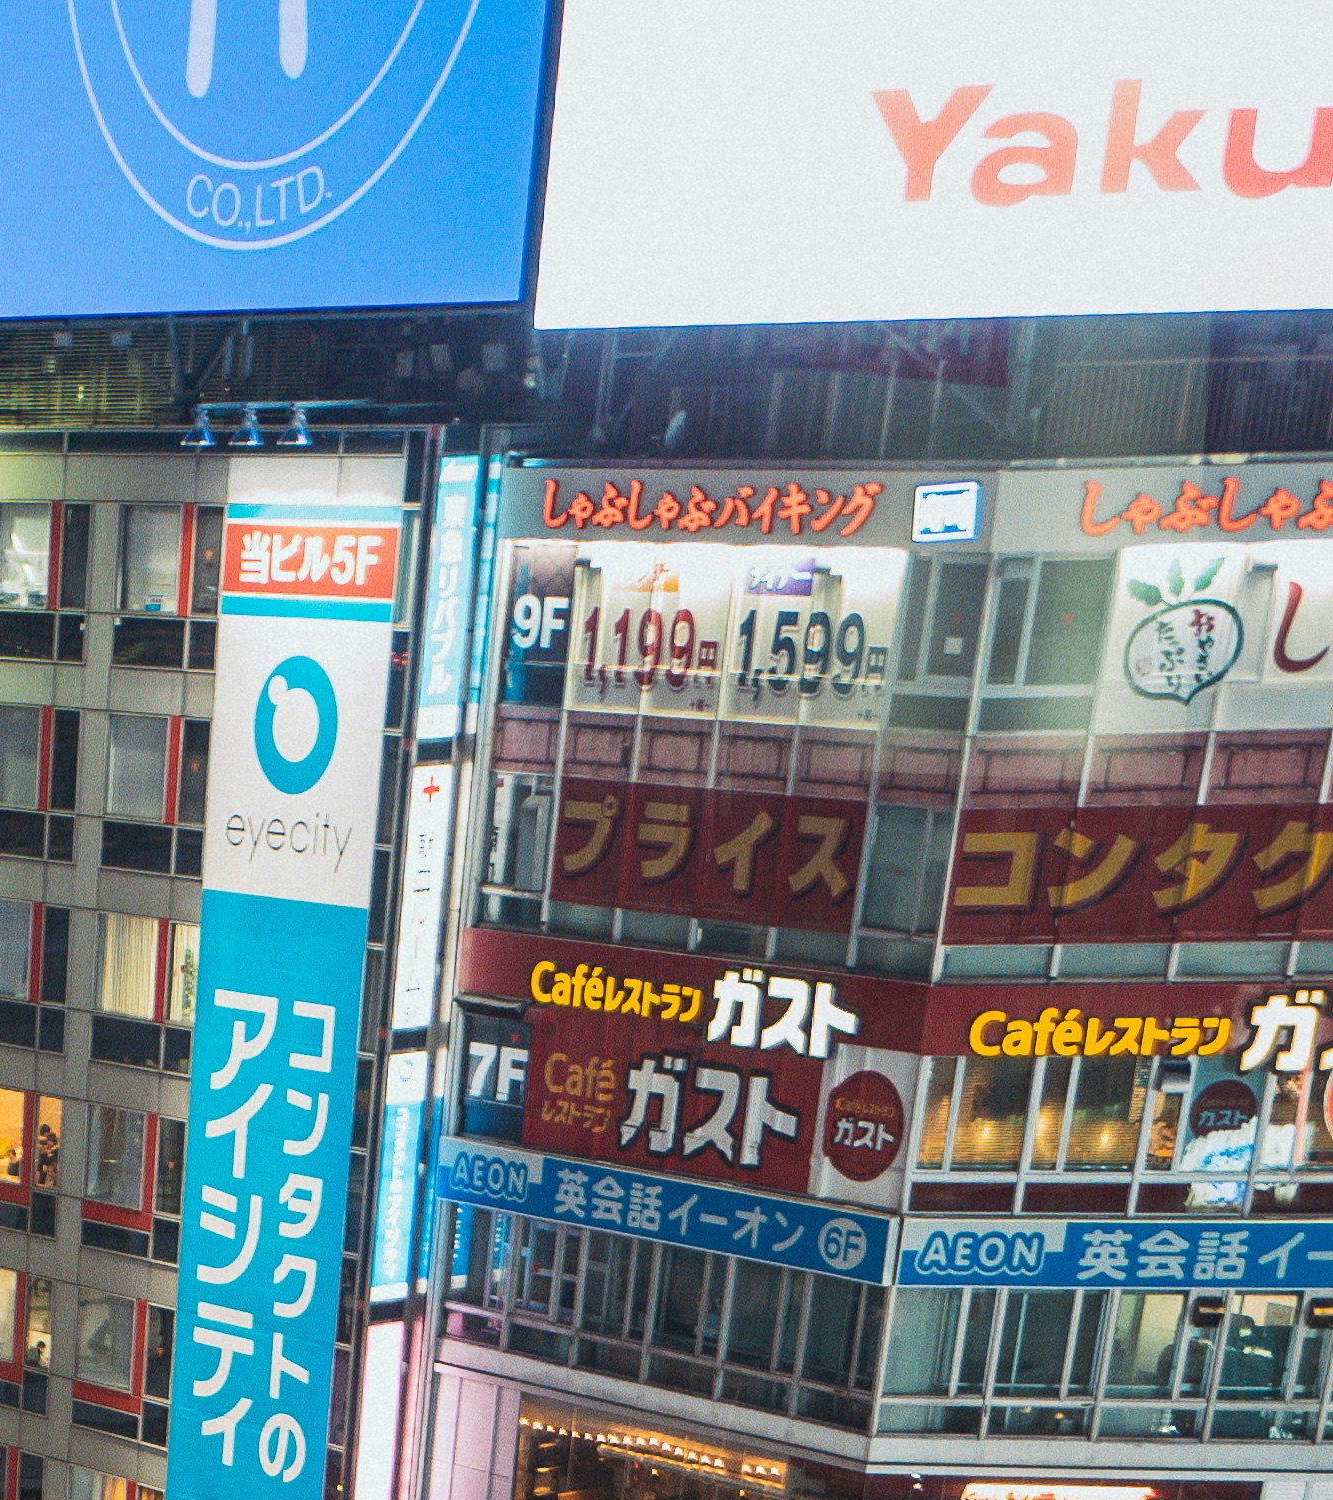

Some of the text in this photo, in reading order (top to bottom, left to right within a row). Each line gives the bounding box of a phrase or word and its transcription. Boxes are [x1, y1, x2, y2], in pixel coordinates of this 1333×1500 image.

[542, 479, 883, 537] しゃぶしゃぶバイキング
[239, 529, 385, 586] 当ビル5F
[511, 594, 570, 650] 9F
[225, 812, 353, 873] eyecity
[562, 794, 851, 897] プライス
[707, 967, 859, 1059] ガスト
[468, 1041, 530, 1102] 7F
[543, 1053, 617, 1102] Café
[620, 1055, 799, 1167] ガスト
[834, 1117, 895, 1152] ガスト
[452, 1153, 530, 1200] AEON
[826, 1224, 862, 1262] 6F
[257, 1000, 337, 1482] コンタクトの
[920, 1235, 1043, 1274] AEON
